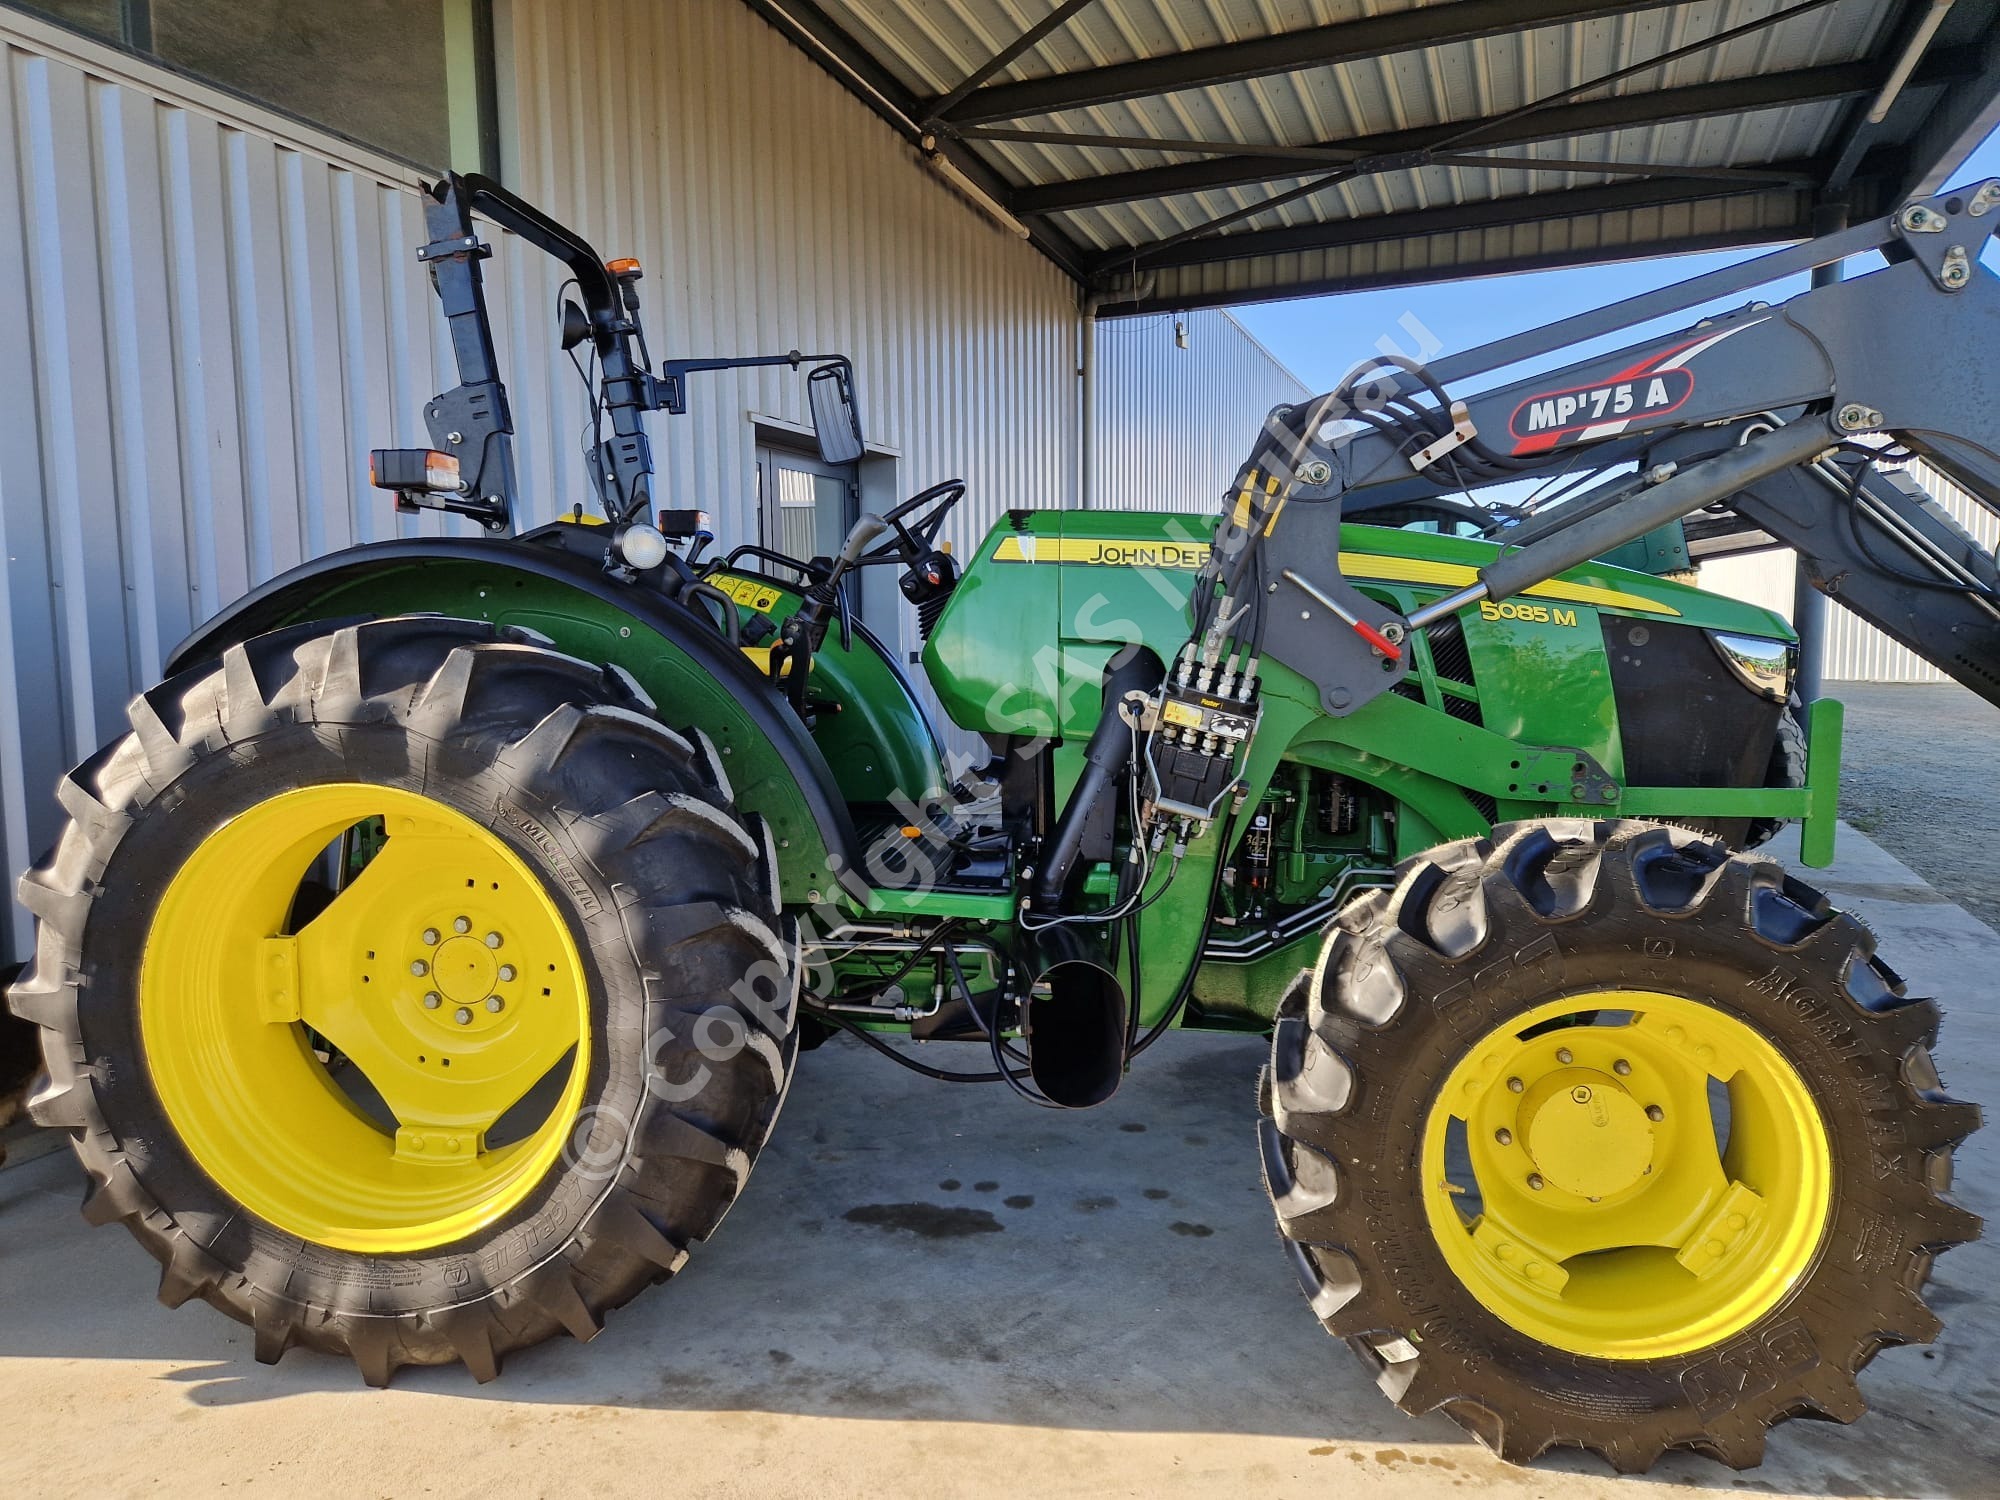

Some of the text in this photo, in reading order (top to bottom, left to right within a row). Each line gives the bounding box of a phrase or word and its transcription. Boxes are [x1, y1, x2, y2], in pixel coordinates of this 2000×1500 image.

[1528, 377, 1669, 431] MP'75 A
[1089, 543, 1211, 566] JOHN DEE
[1480, 600, 1577, 627] 5085 M
[518, 819, 599, 911] MICHELIN
